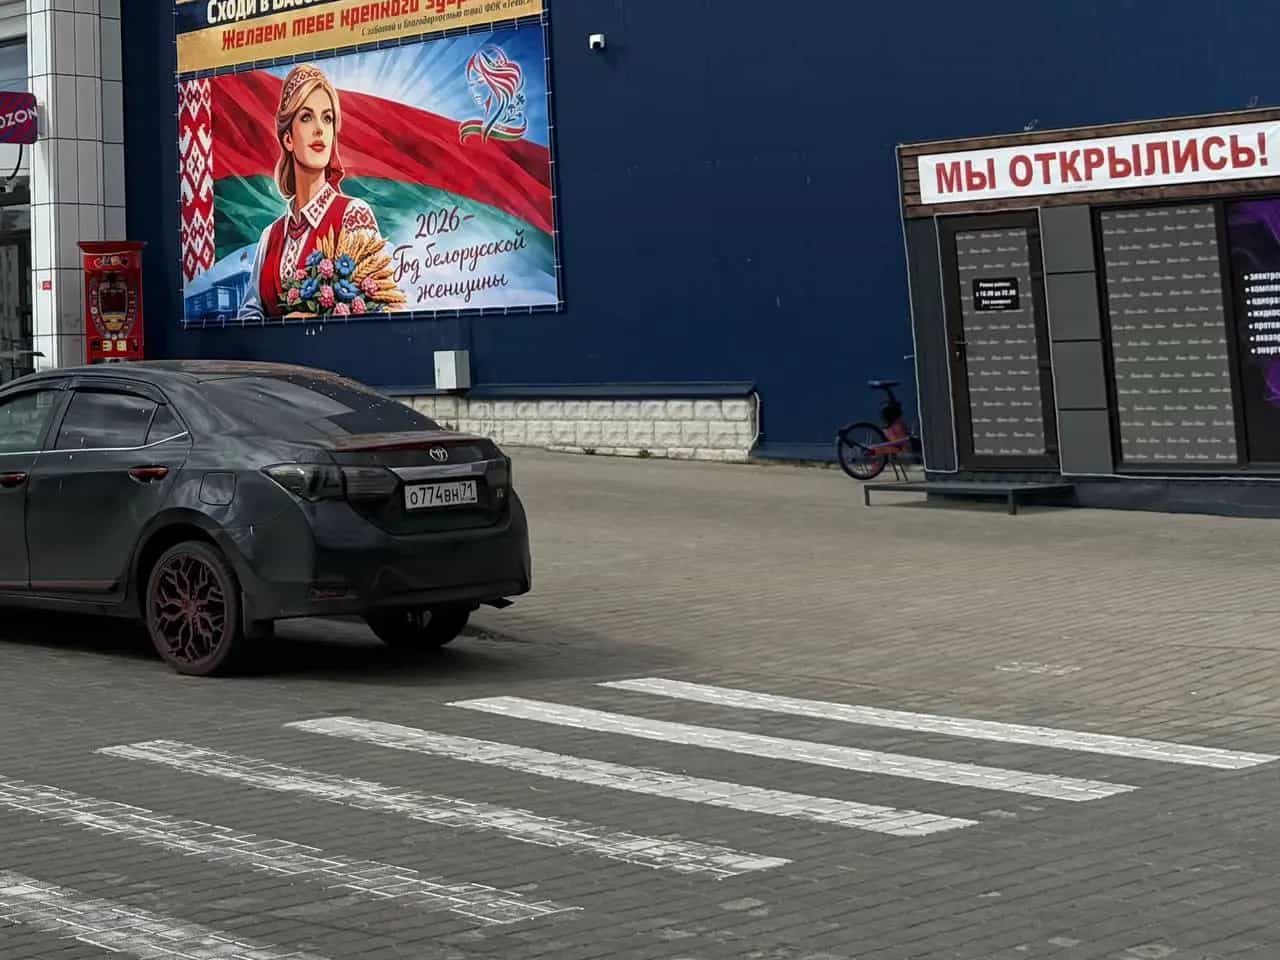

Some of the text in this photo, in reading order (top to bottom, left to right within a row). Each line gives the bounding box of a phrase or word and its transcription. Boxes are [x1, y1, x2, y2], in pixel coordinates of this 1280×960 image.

[222, 22, 287, 51] Желаем
[292, 12, 334, 38] тебе
[935, 132, 1268, 193] МЫ ОТКРЫЛИСЬ!
[393, 229, 527, 284] Год белорусской
[417, 273, 508, 303] женщины
[461, 482, 473, 497] 71
